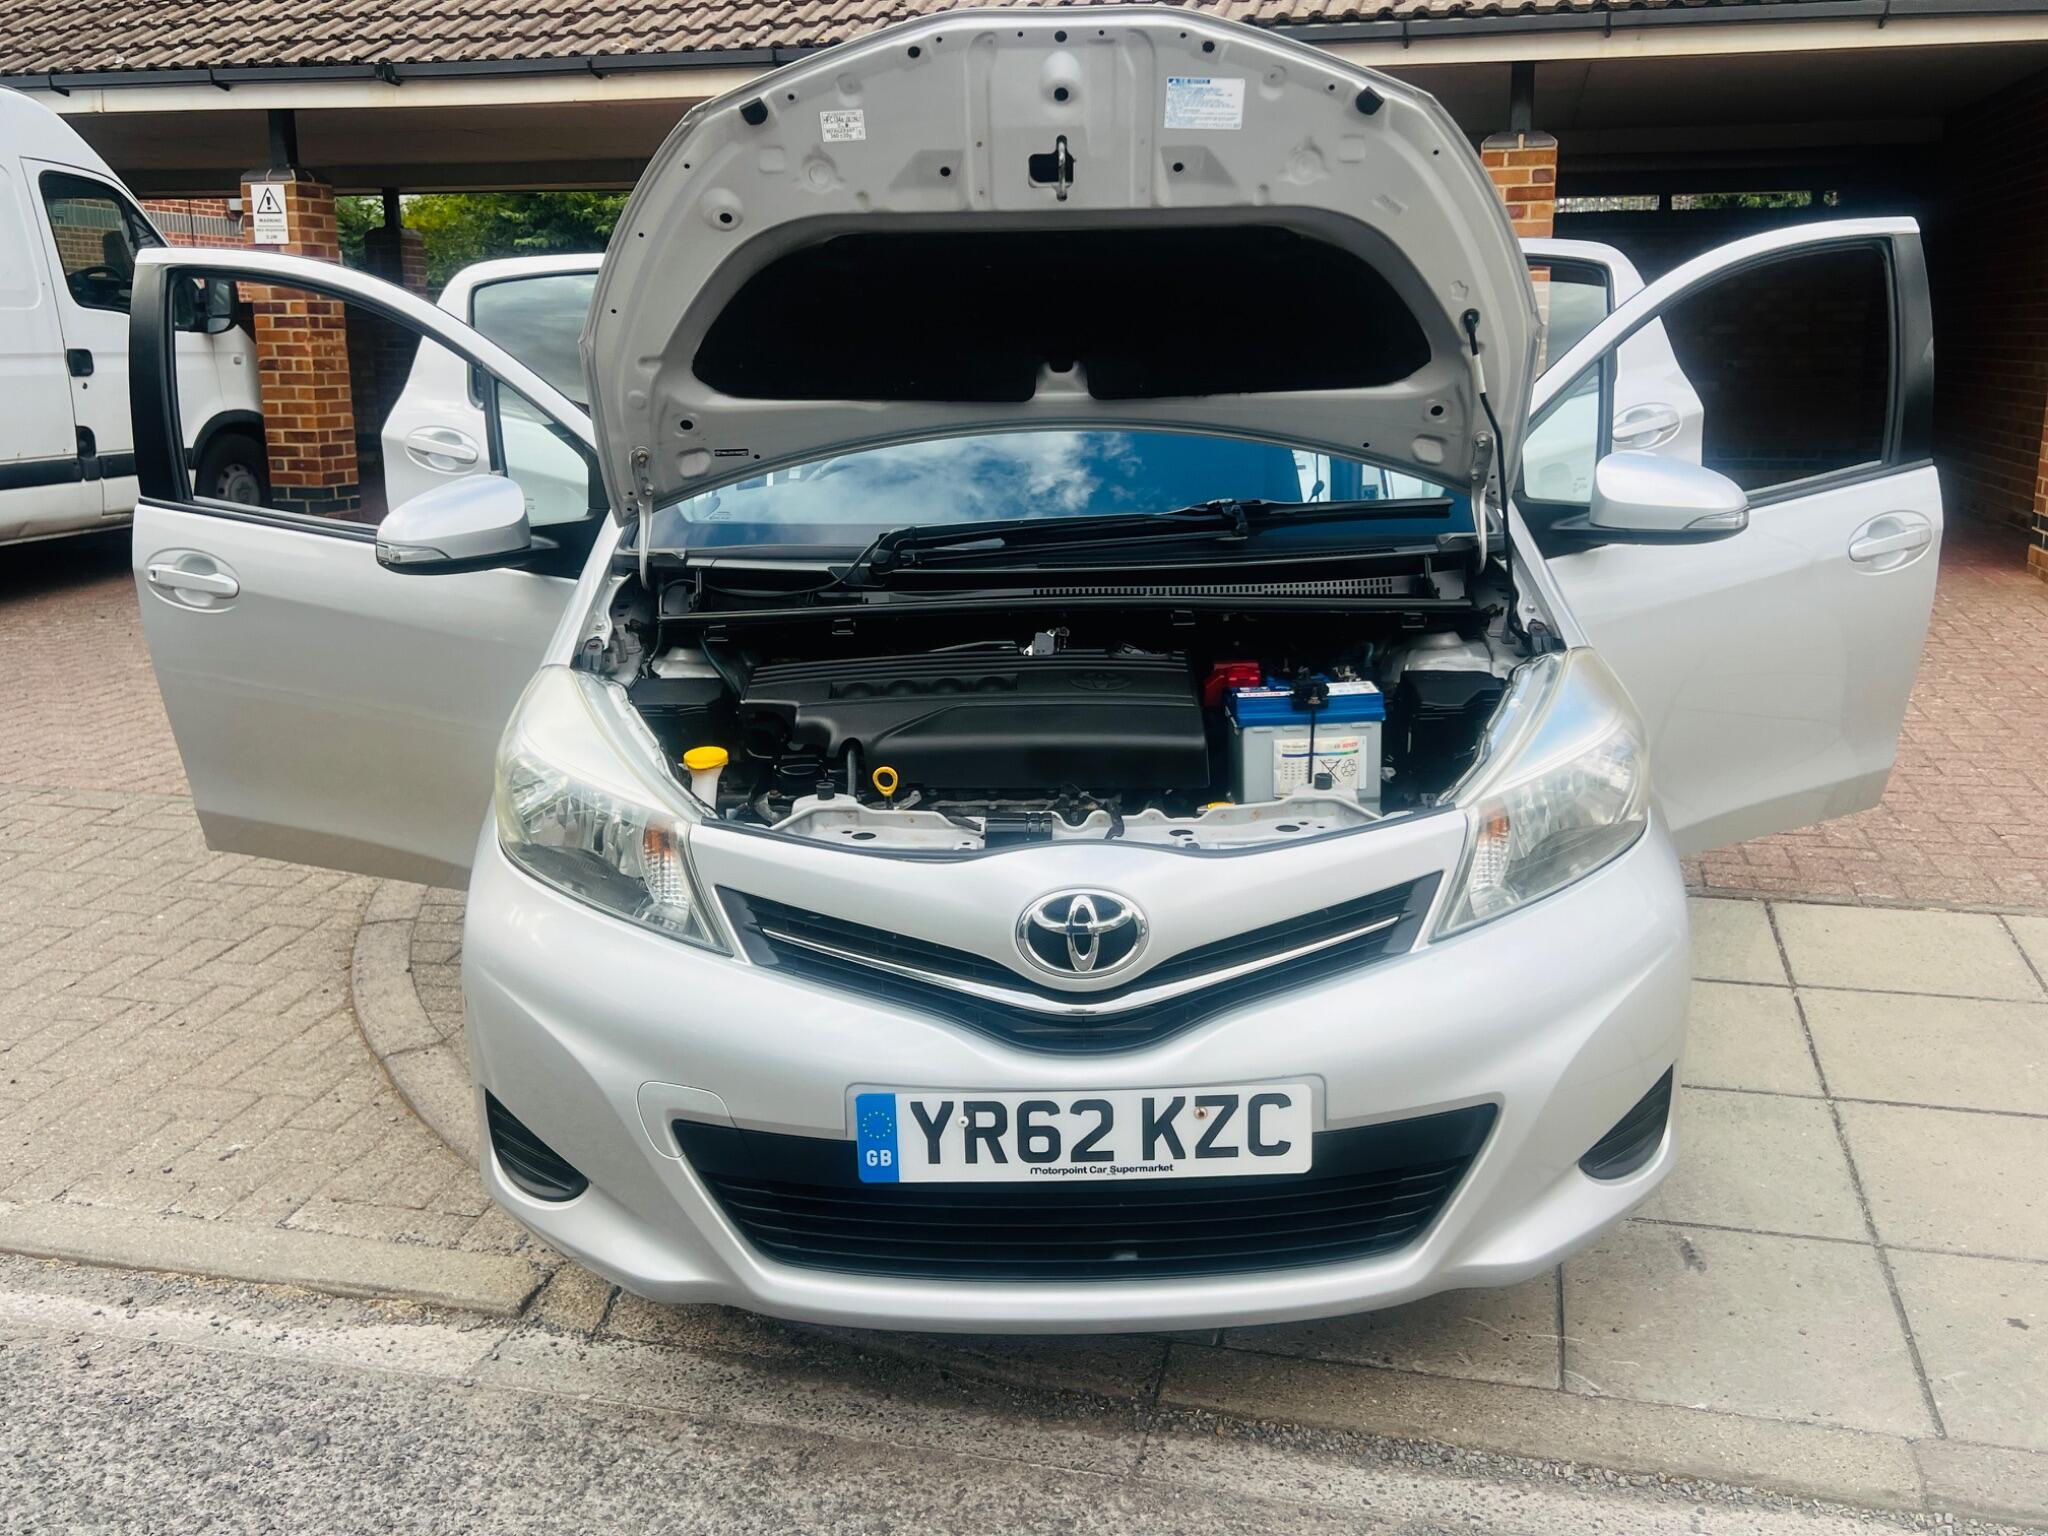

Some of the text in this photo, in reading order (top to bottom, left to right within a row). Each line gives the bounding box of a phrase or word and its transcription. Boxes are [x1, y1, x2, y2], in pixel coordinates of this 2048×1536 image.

[910, 1093, 1292, 1164] YR62 KZC
[866, 1150, 892, 1167] GB
[1030, 1164, 1174, 1176] Motorpoint Car Supermarket
